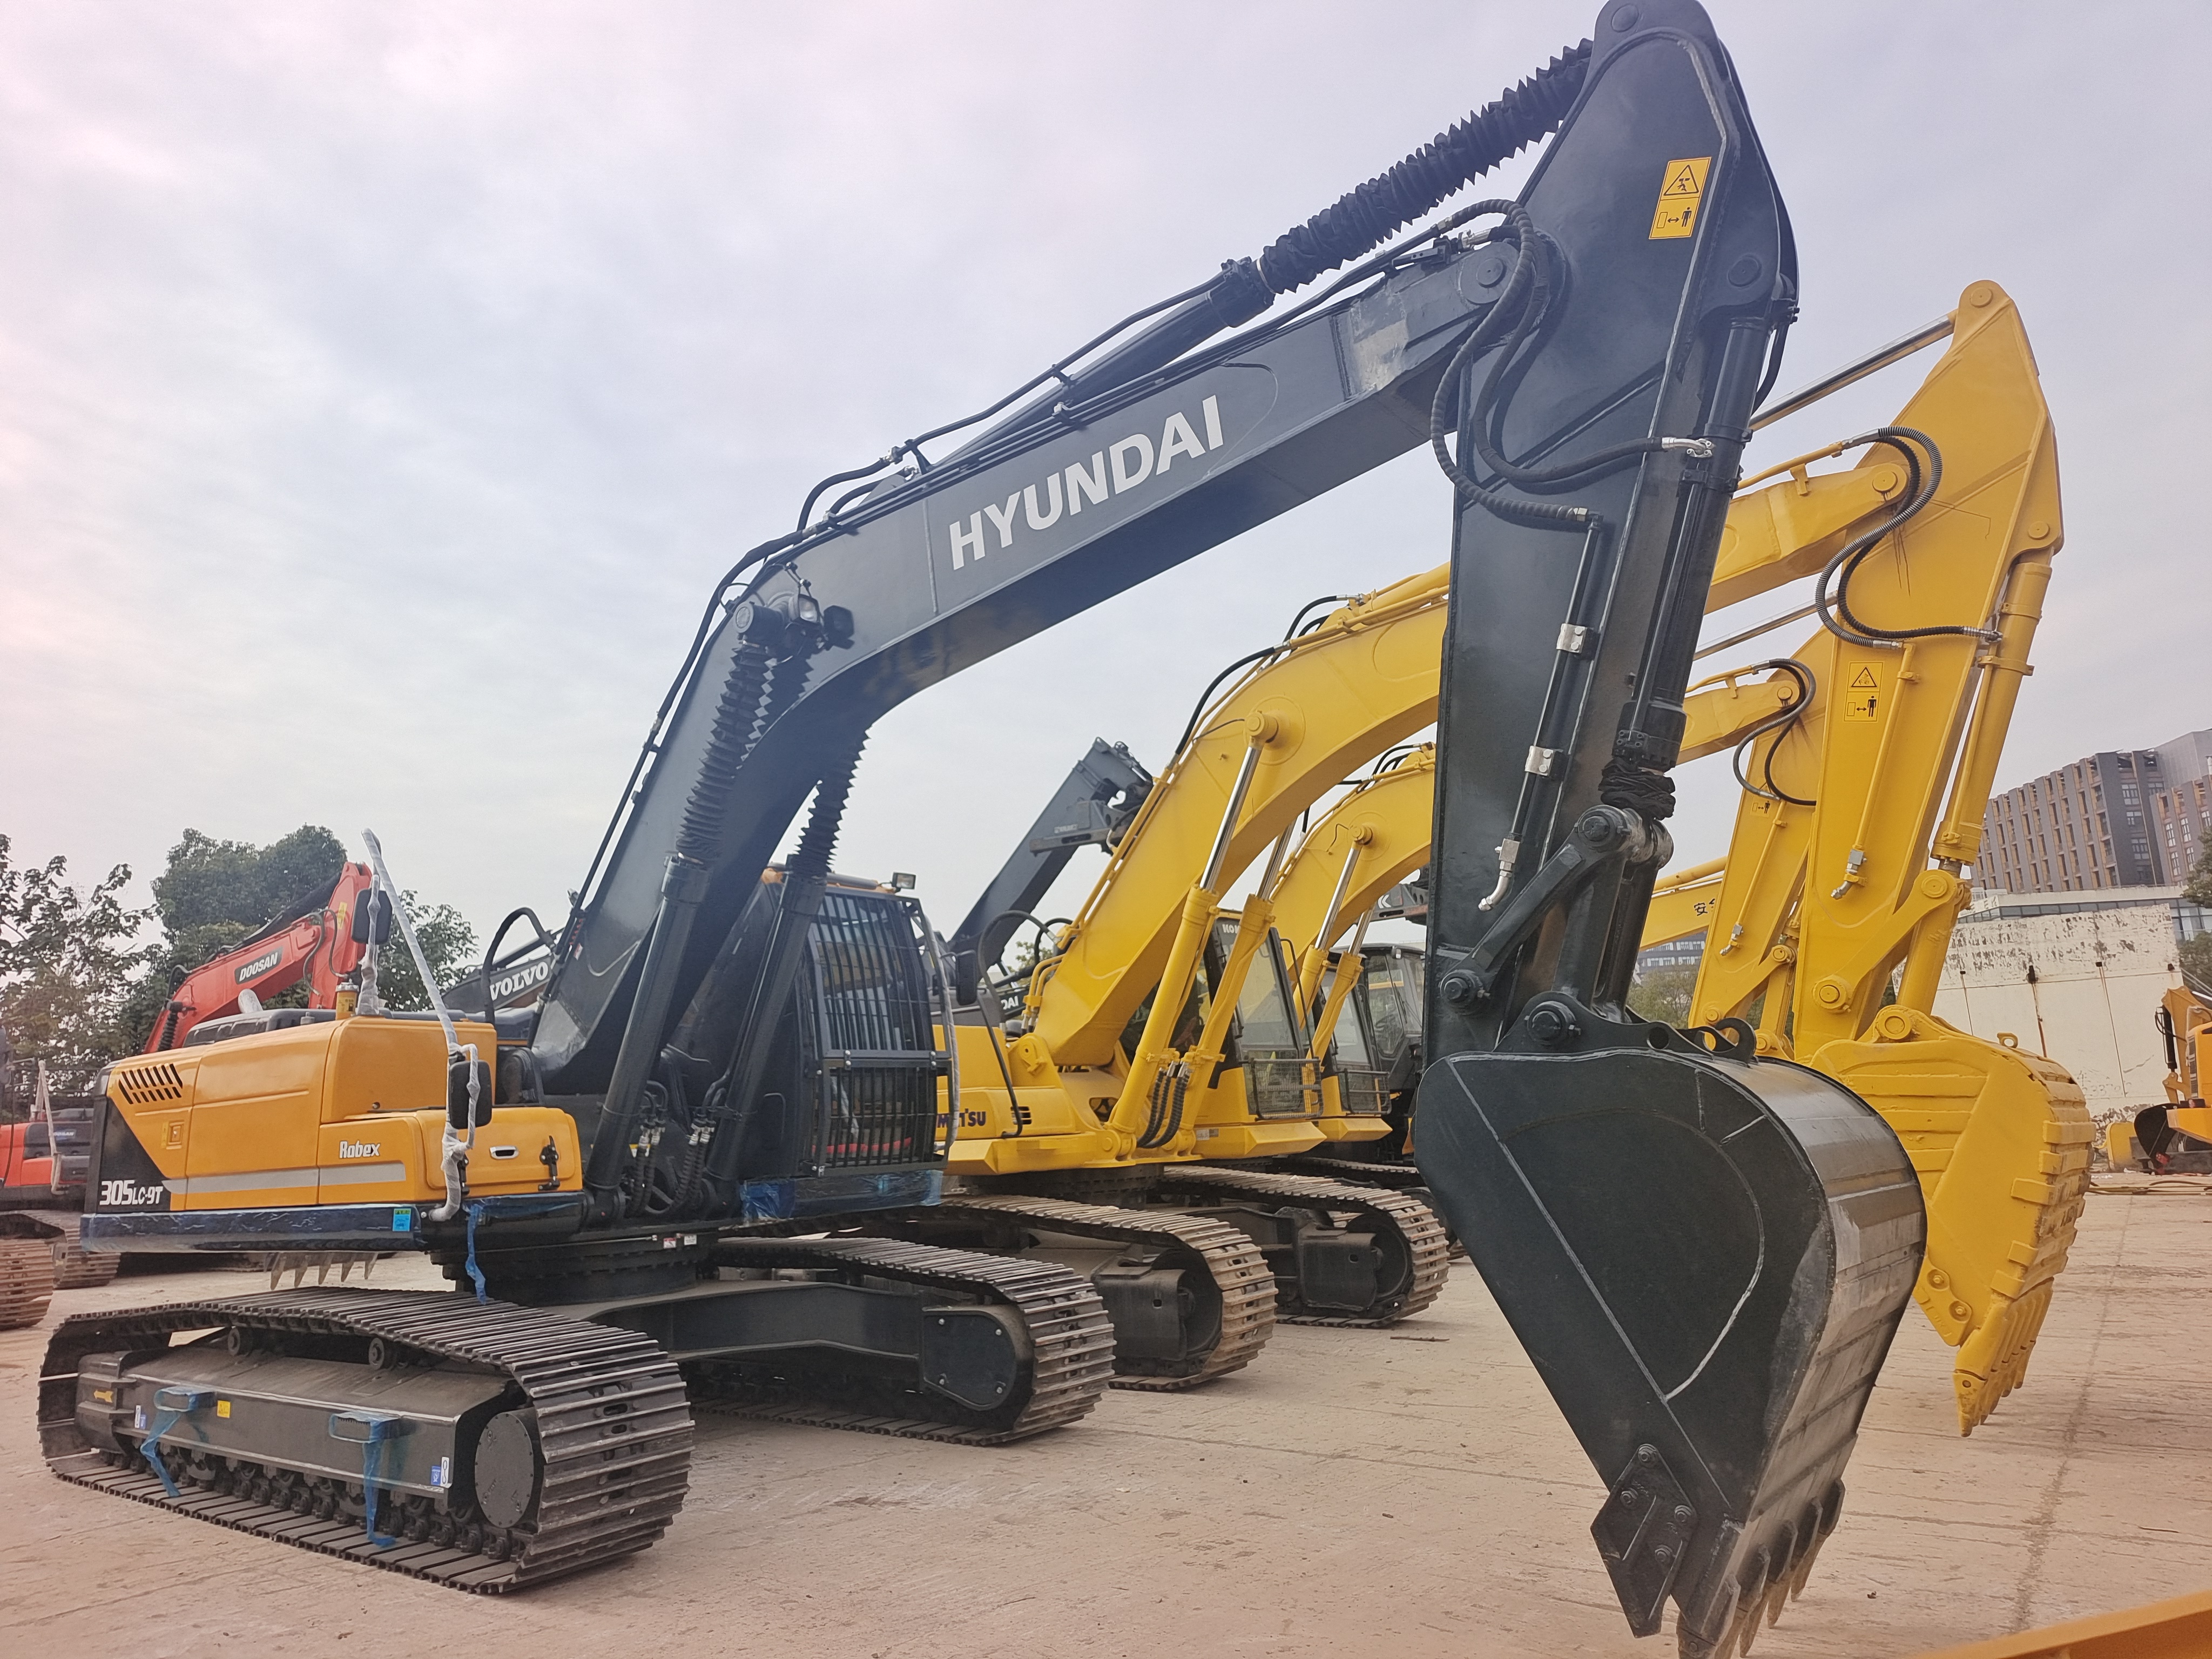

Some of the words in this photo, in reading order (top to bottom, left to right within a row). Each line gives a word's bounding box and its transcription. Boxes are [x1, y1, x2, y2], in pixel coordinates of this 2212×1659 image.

[949, 395, 1224, 570] HYUNDAI
[1222, 924, 1240, 934] KOM
[239, 952, 278, 982] DOOSAN
[489, 961, 549, 1001] VOLVO
[1001, 995, 1019, 1010] DAI
[339, 1140, 381, 1158] Robex
